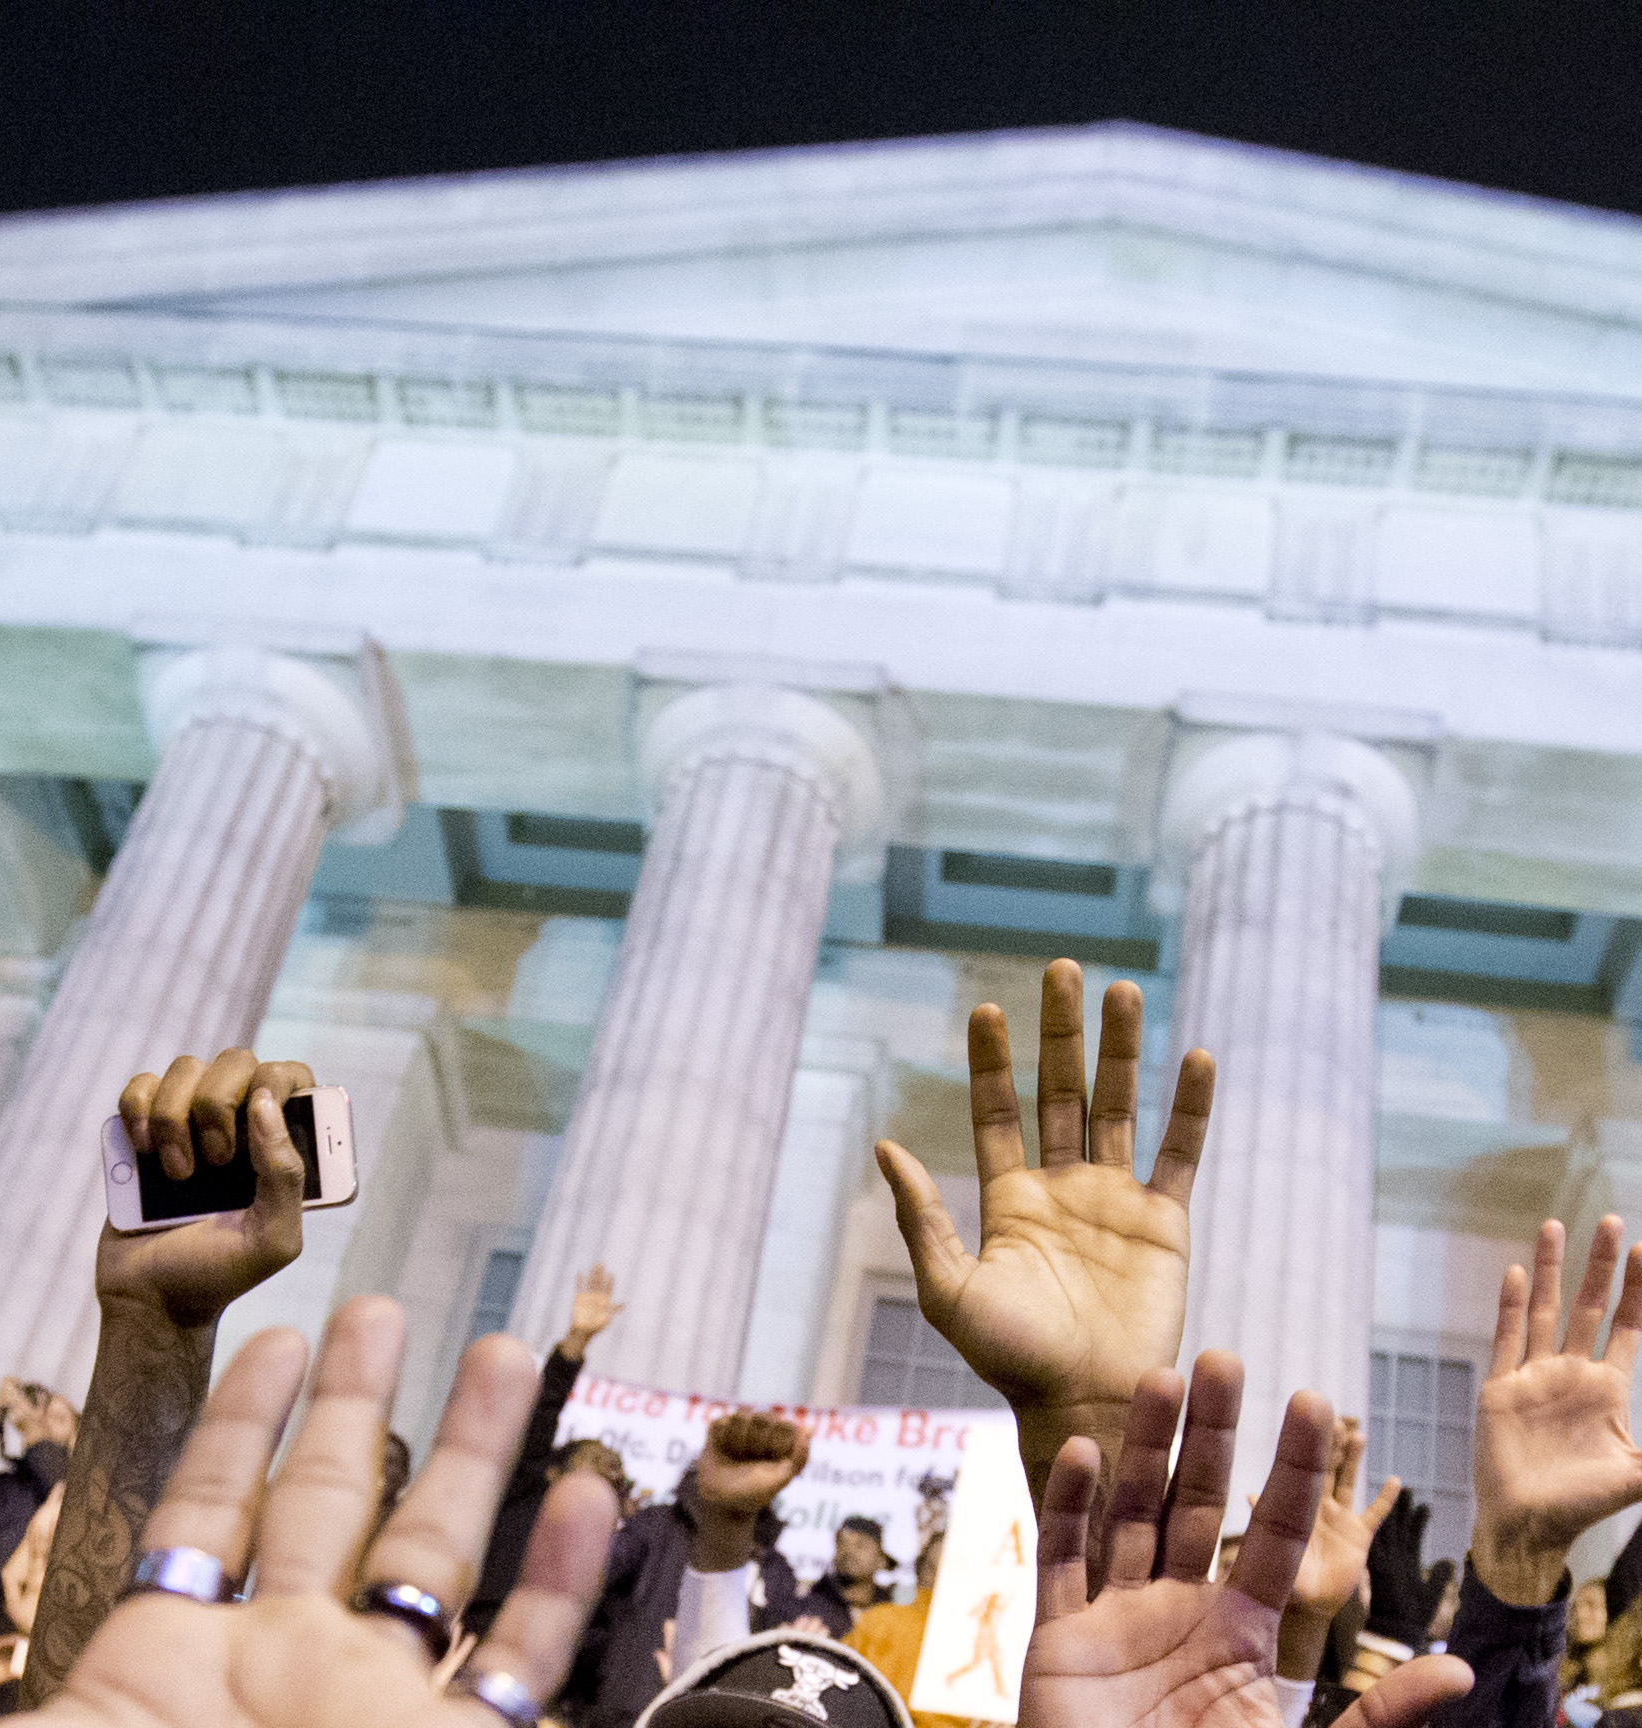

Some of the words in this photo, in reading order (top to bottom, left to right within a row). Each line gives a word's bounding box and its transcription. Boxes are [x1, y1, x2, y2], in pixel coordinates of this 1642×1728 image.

[568, 1378, 670, 1419] tice
[683, 1393, 735, 1423] fo
[770, 1404, 879, 1447] ike
[799, 1460, 884, 1487] ilson
